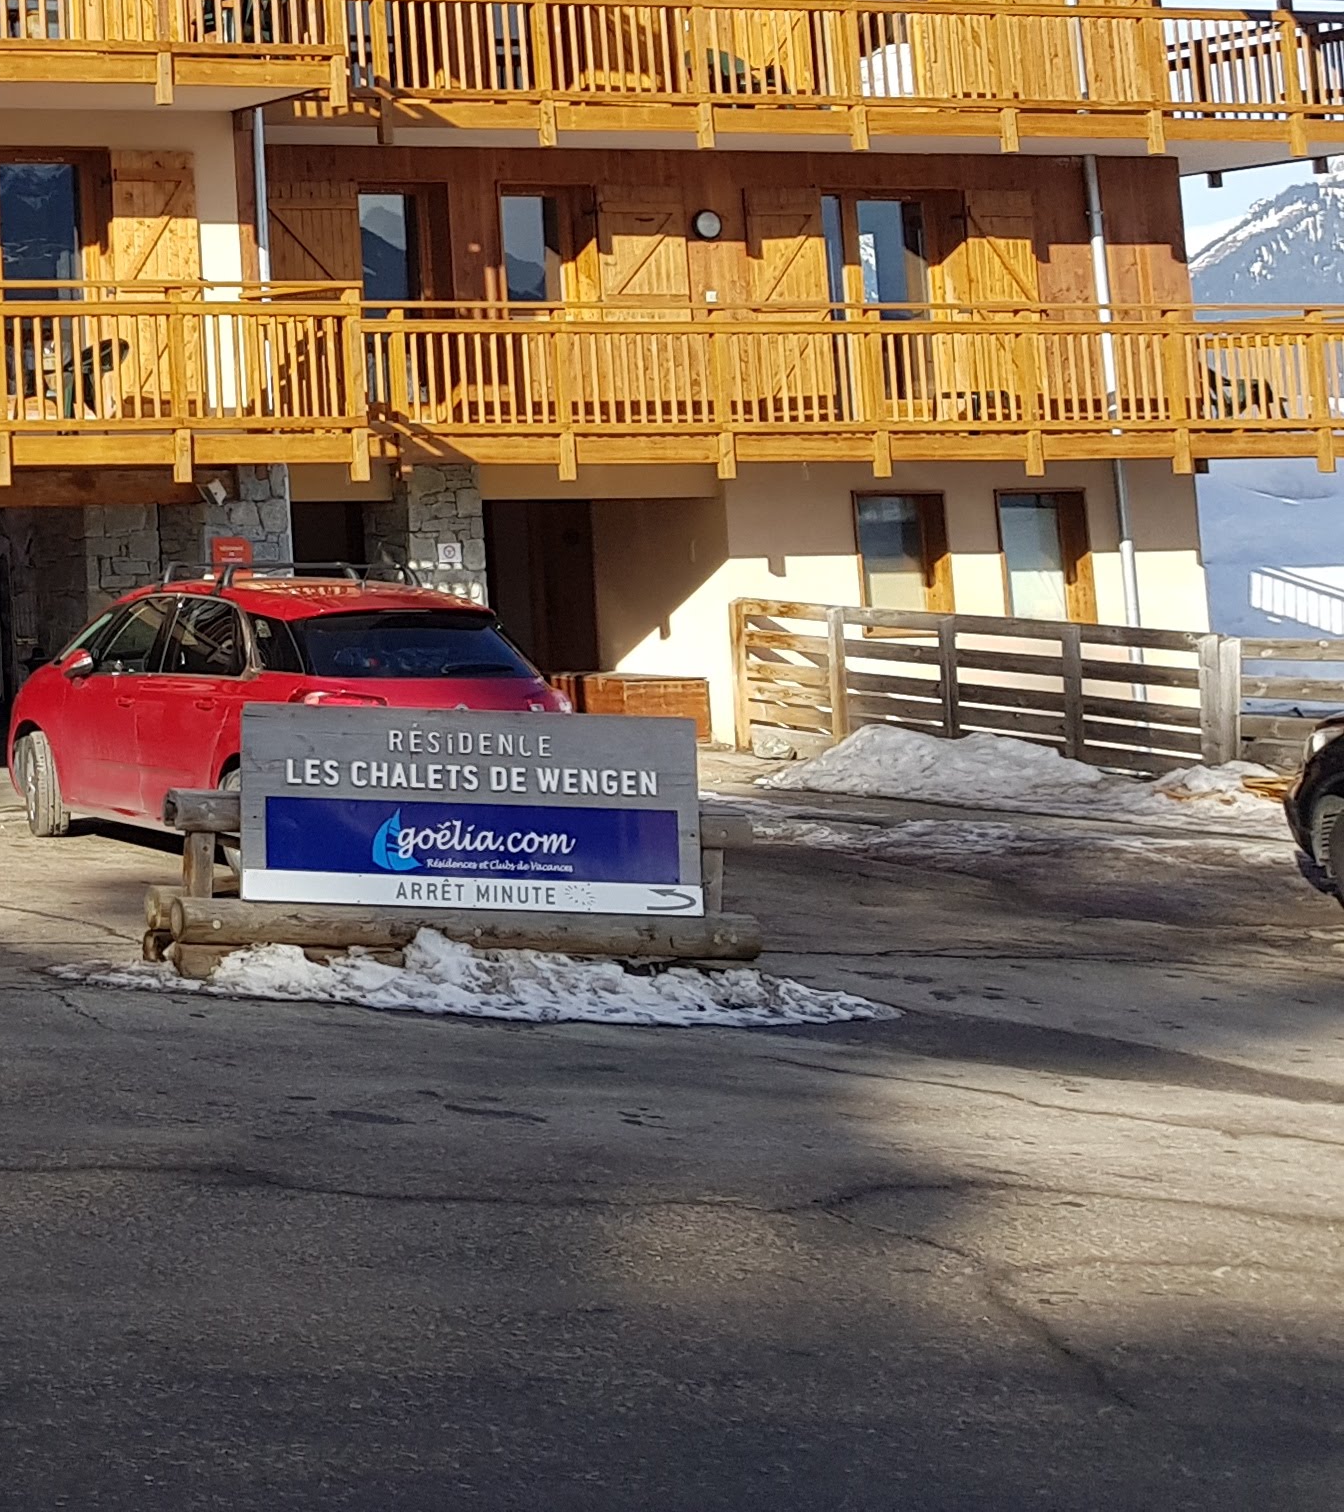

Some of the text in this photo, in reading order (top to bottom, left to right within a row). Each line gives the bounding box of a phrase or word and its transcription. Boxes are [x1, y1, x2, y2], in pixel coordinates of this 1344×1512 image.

[286, 758, 658, 796] LES CHALETS DE WENGEN
[396, 879, 556, 905] ARRÊT MINUTE
